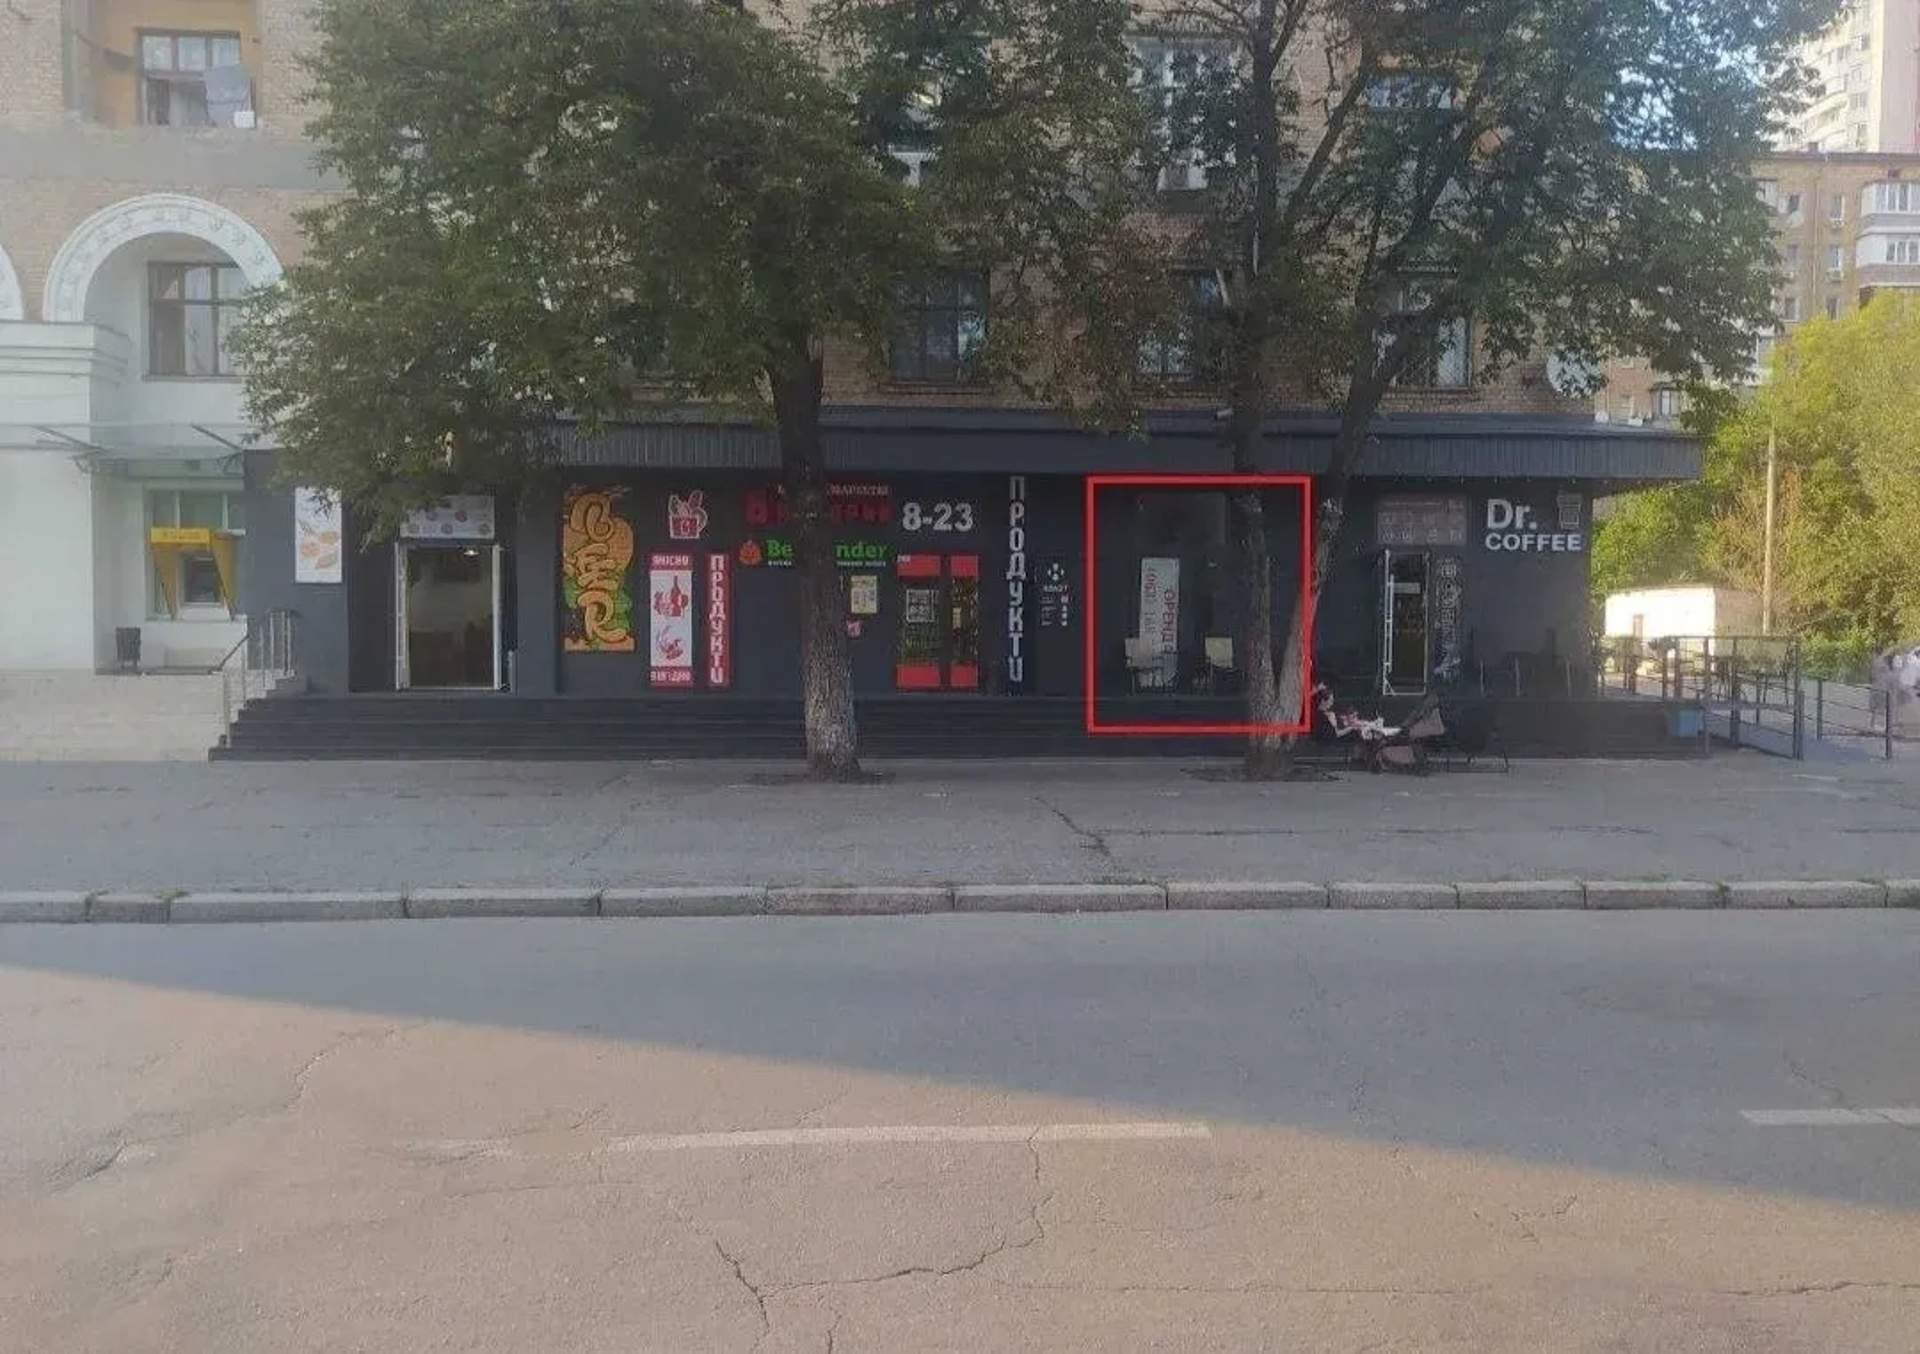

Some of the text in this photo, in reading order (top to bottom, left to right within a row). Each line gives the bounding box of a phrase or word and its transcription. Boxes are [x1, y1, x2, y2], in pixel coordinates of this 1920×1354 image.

[902, 501, 973, 532] 8-23
[1486, 498, 1537, 529] Dr.
[1484, 532, 1584, 552] COFFEE
[1006, 476, 1026, 682] ПРОДУКТИ
[708, 554, 726, 684] ПРОДУКТИ
